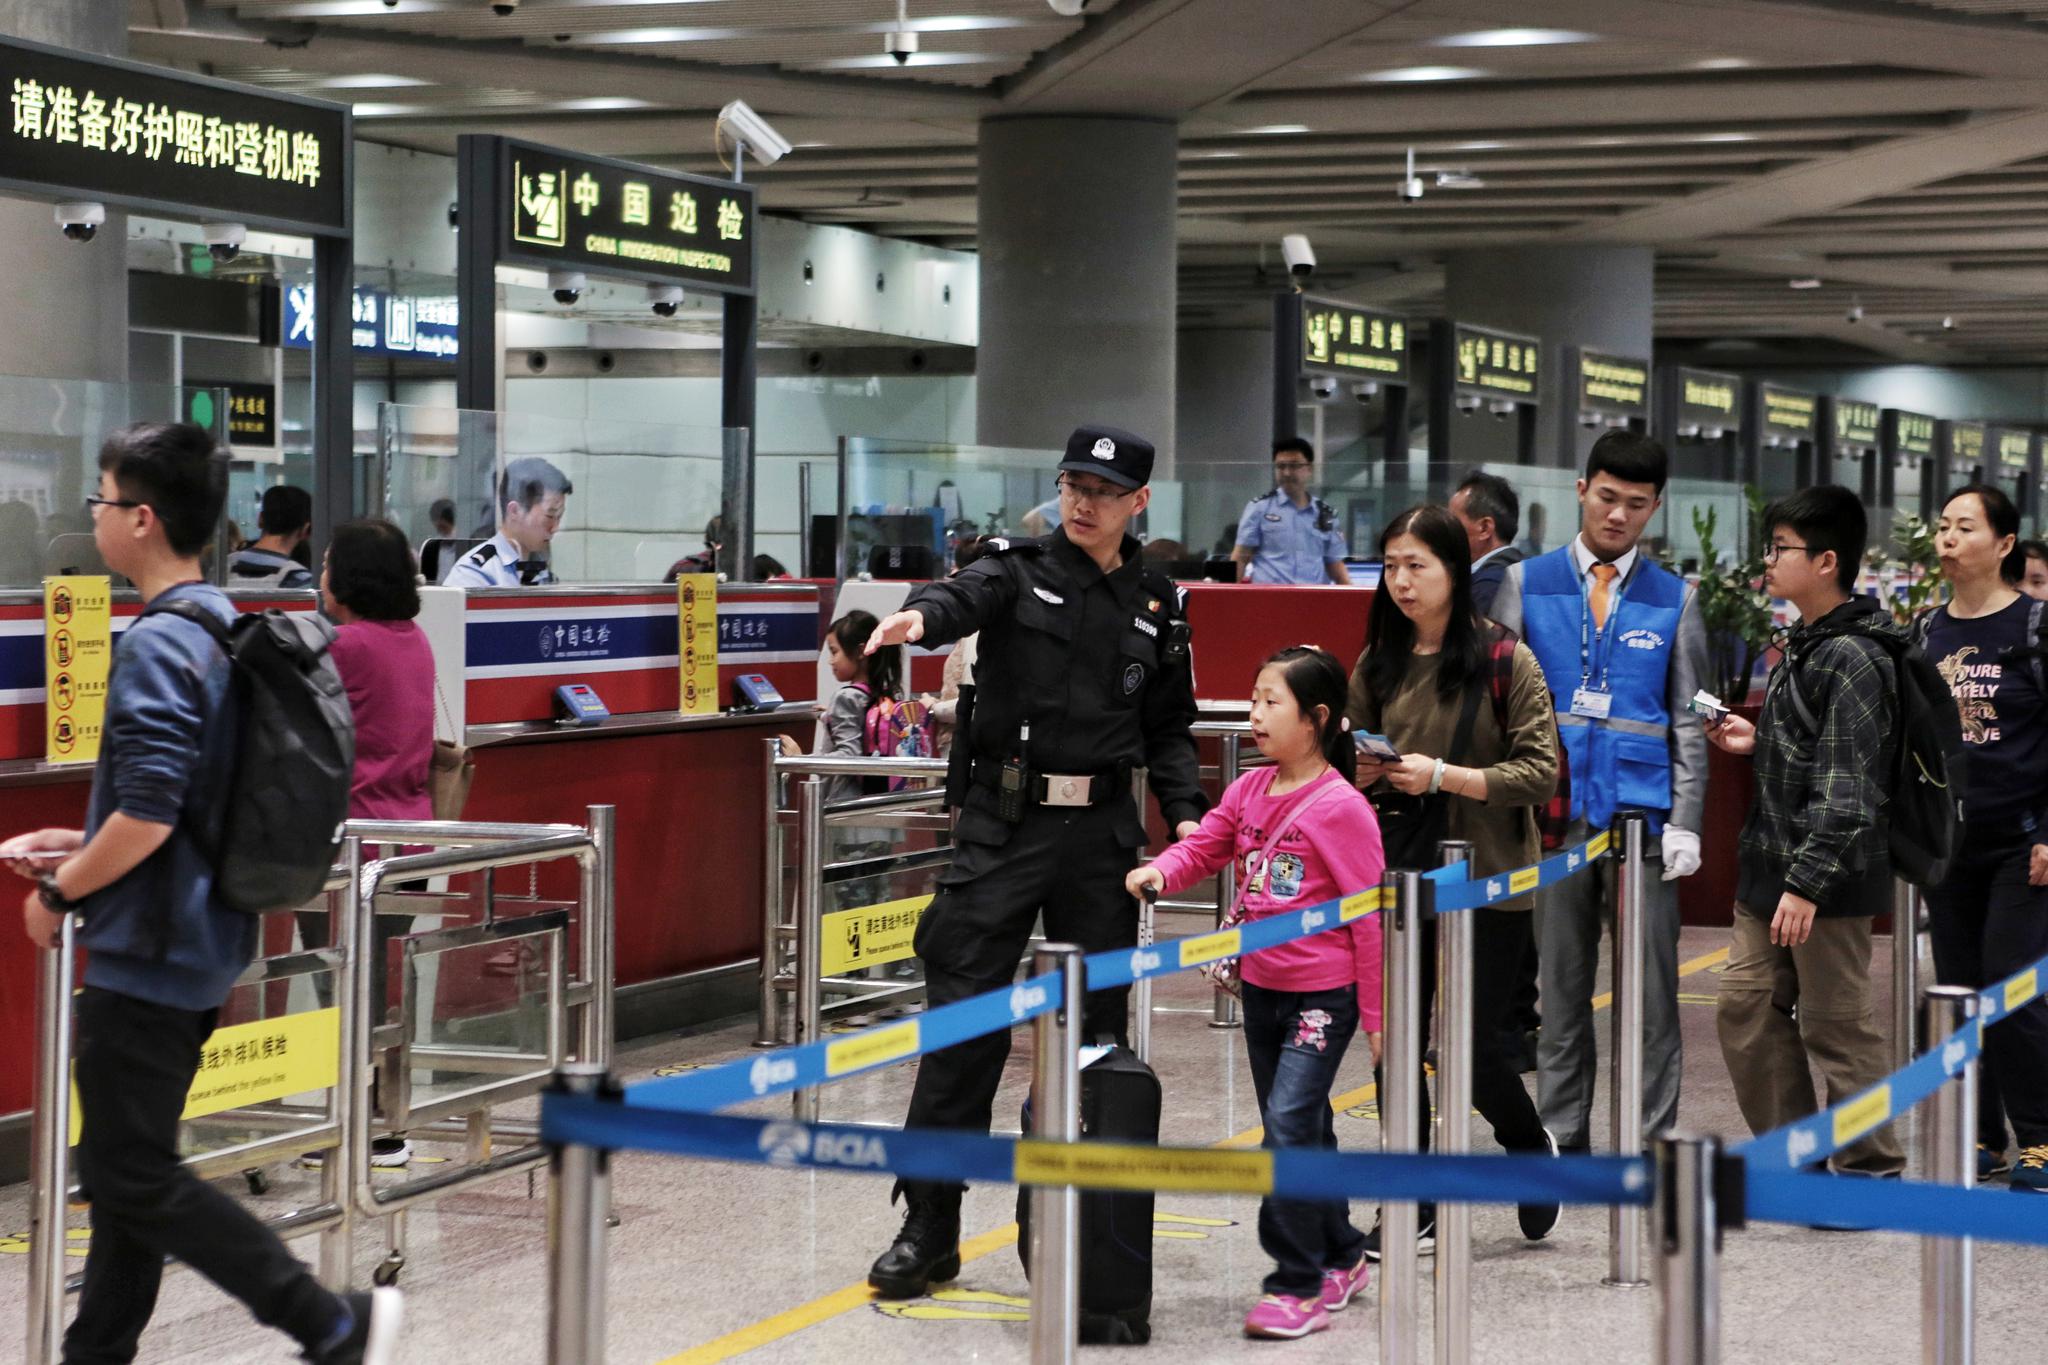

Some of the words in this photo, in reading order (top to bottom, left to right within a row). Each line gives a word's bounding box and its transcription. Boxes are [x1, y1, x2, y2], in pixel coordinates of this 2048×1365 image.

[11, 78, 321, 188] 请准备好护照和登机牌
[573, 172, 744, 241] 中国边检
[812, 1131, 888, 1169] BCIA
